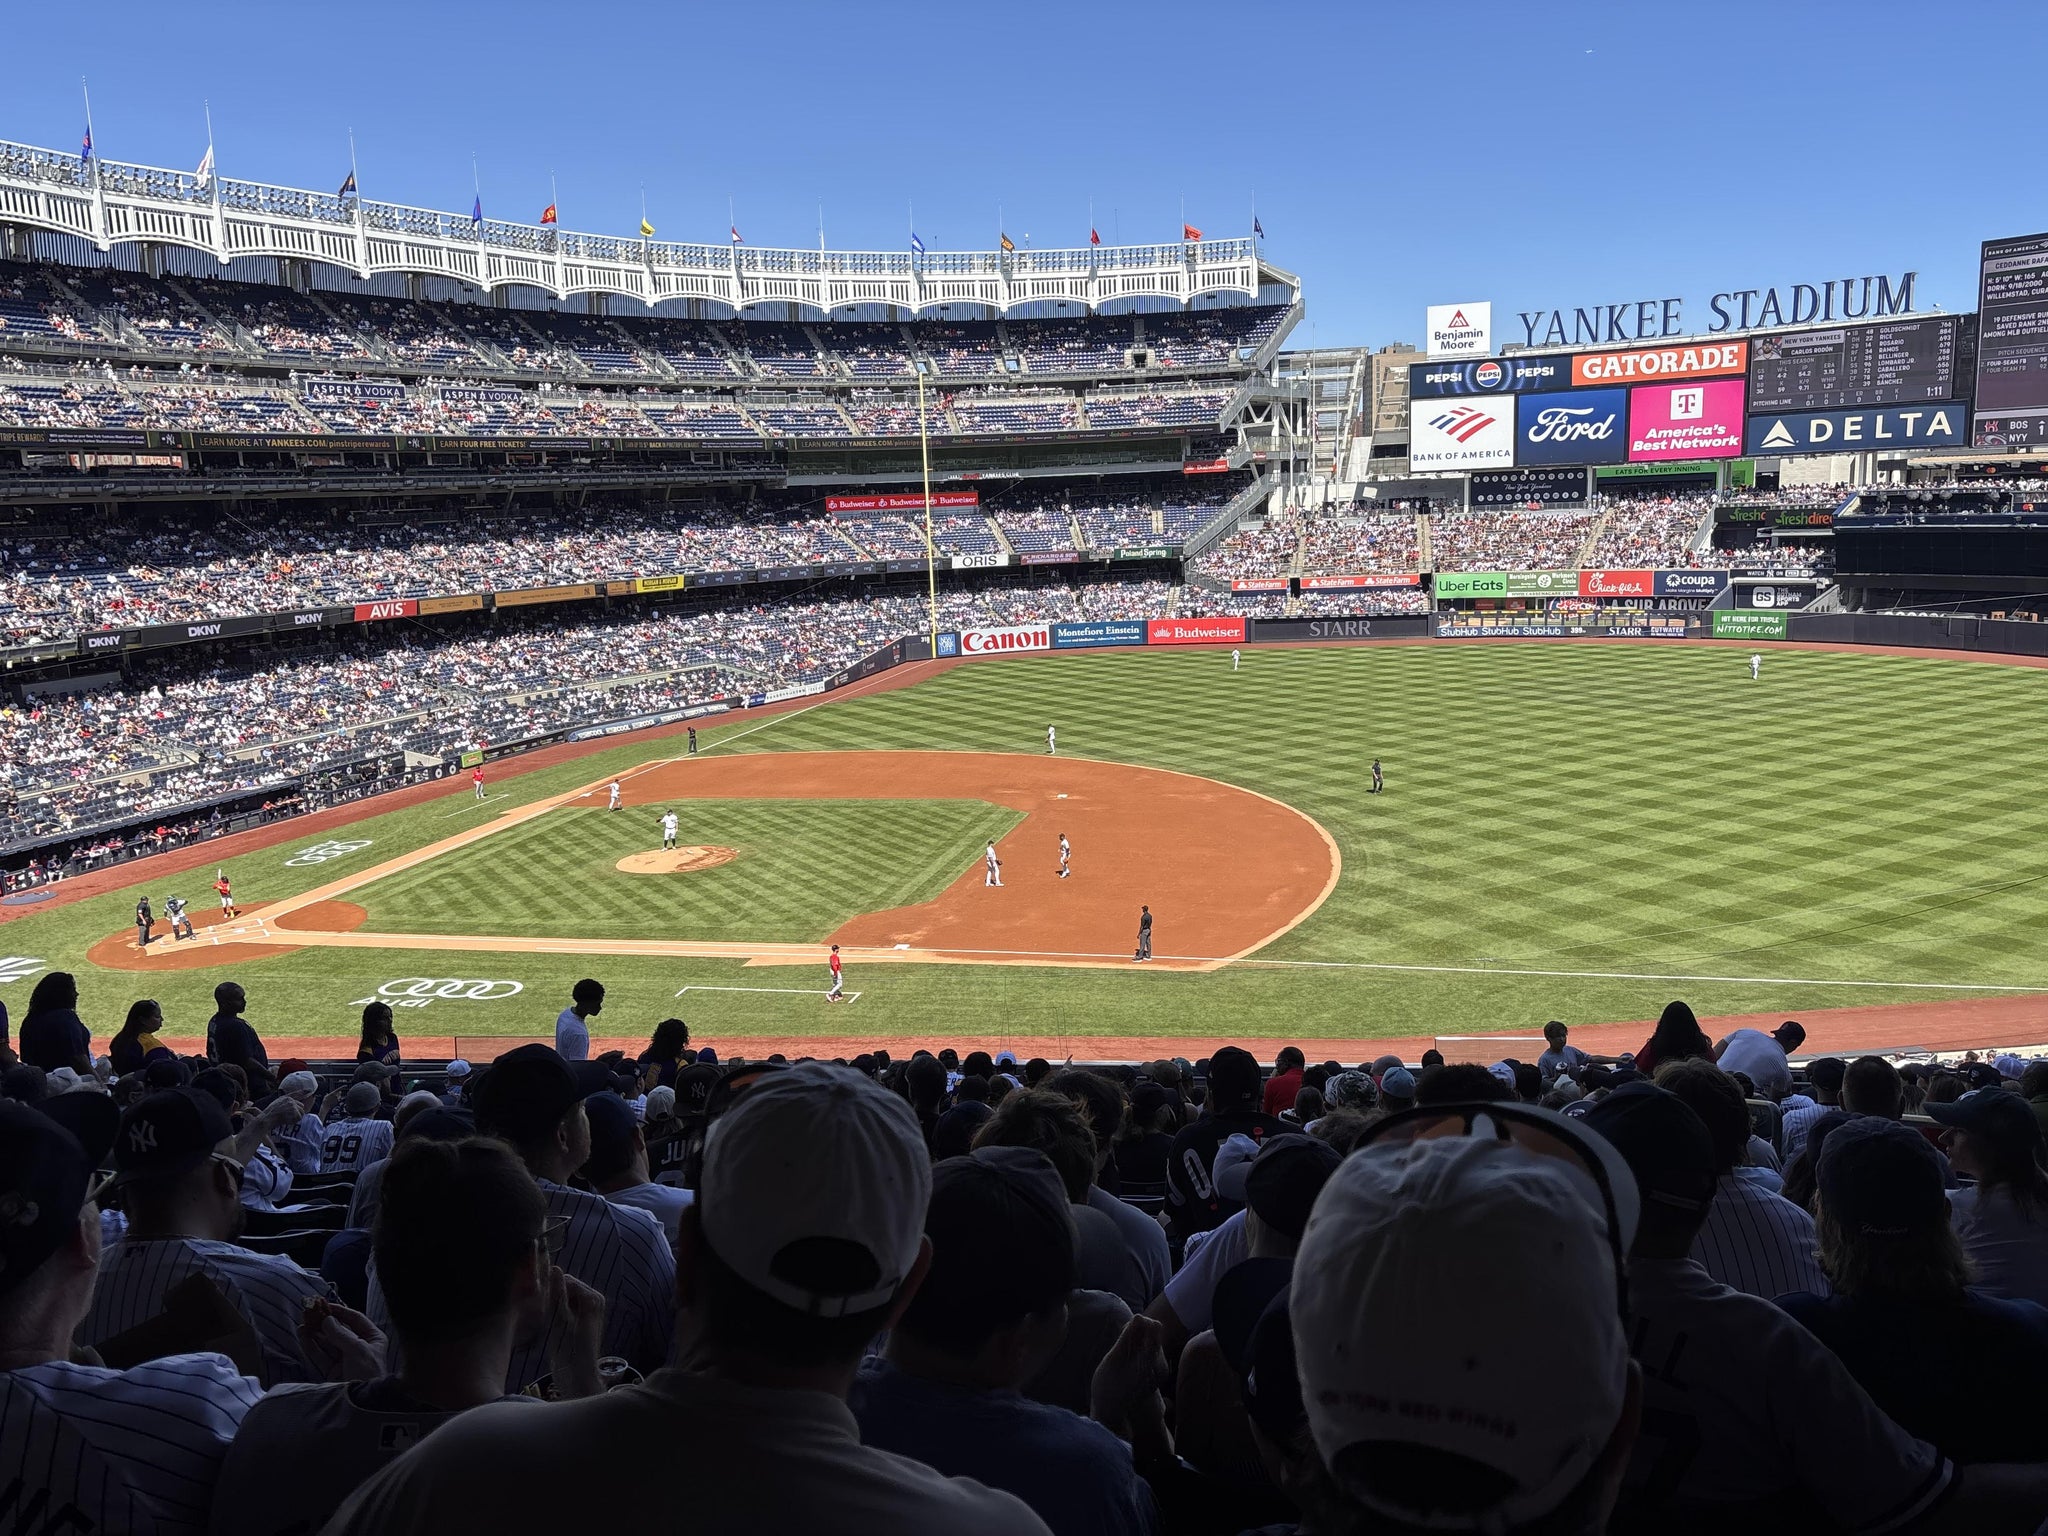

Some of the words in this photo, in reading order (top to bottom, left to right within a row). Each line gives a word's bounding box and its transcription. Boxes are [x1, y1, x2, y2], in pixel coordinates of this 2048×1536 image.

[1517, 298, 1682, 348] YANKEE
[1708, 272, 1918, 332] STADIUM
[2002, 313, 2036, 322] DEFENSIVE
[1880, 325, 1920, 333] GOLDSCHMIDT
[1434, 329, 1483, 342] Benjamin
[1814, 334, 1841, 342] YANKEES
[1441, 340, 1476, 350] Moore
[1582, 346, 1739, 379] GATORADE
[1426, 372, 1462, 384] PEPSI
[1478, 370, 1500, 378] PEPSI
[1516, 366, 1554, 378] PEPSI
[313, 384, 351, 395] ASPEN
[364, 385, 400, 397] VODKA
[444, 390, 477, 400] ASPEN
[488, 392, 520, 403] VODKA
[1926, 387, 1942, 396] 1:11
[1528, 407, 1616, 443] Ford
[1809, 411, 1953, 443] DELTA
[2010, 421, 2028, 429] BOS
[1645, 424, 1727, 439] America's
[227, 439, 251, 447] MORE
[1632, 439, 1668, 452] Best
[1670, 435, 1740, 449] Network
[2009, 434, 2027, 442] NYY
[1413, 453, 1443, 462] BANK
[1446, 452, 1459, 460] OF
[1461, 449, 1511, 460] AMERICA
[839, 500, 875, 508] Budweiser
[890, 498, 925, 506] Budweiser
[939, 496, 976, 504] Budweiser
[1120, 549, 1143, 558] Poland
[1144, 549, 1167, 558] Spring
[962, 555, 997, 566] ORIS
[1439, 581, 1469, 591] Uber
[1472, 580, 1503, 590] Eats
[1588, 578, 1643, 594] Chick-fil-A
[1681, 575, 1715, 587] coupa
[1756, 592, 1771, 602] GS
[370, 602, 404, 619] AVIS
[294, 613, 323, 625] DKNY
[188, 624, 222, 637] DKNY
[1058, 627, 1104, 637] Montefiore
[1106, 625, 1140, 634] Einstein
[1309, 620, 1371, 637] STARR
[1440, 628, 1478, 636] StubHub
[1481, 627, 1519, 636] StubHub
[1522, 627, 1561, 635] StubHub
[1609, 627, 1641, 636] STARR
[1717, 625, 1782, 634] NITTOTIRE.COM
[88, 636, 121, 648] DKNY
[963, 630, 1048, 652] Canon
[129, 1119, 157, 1153] NY
[323, 1135, 361, 1163] 99
